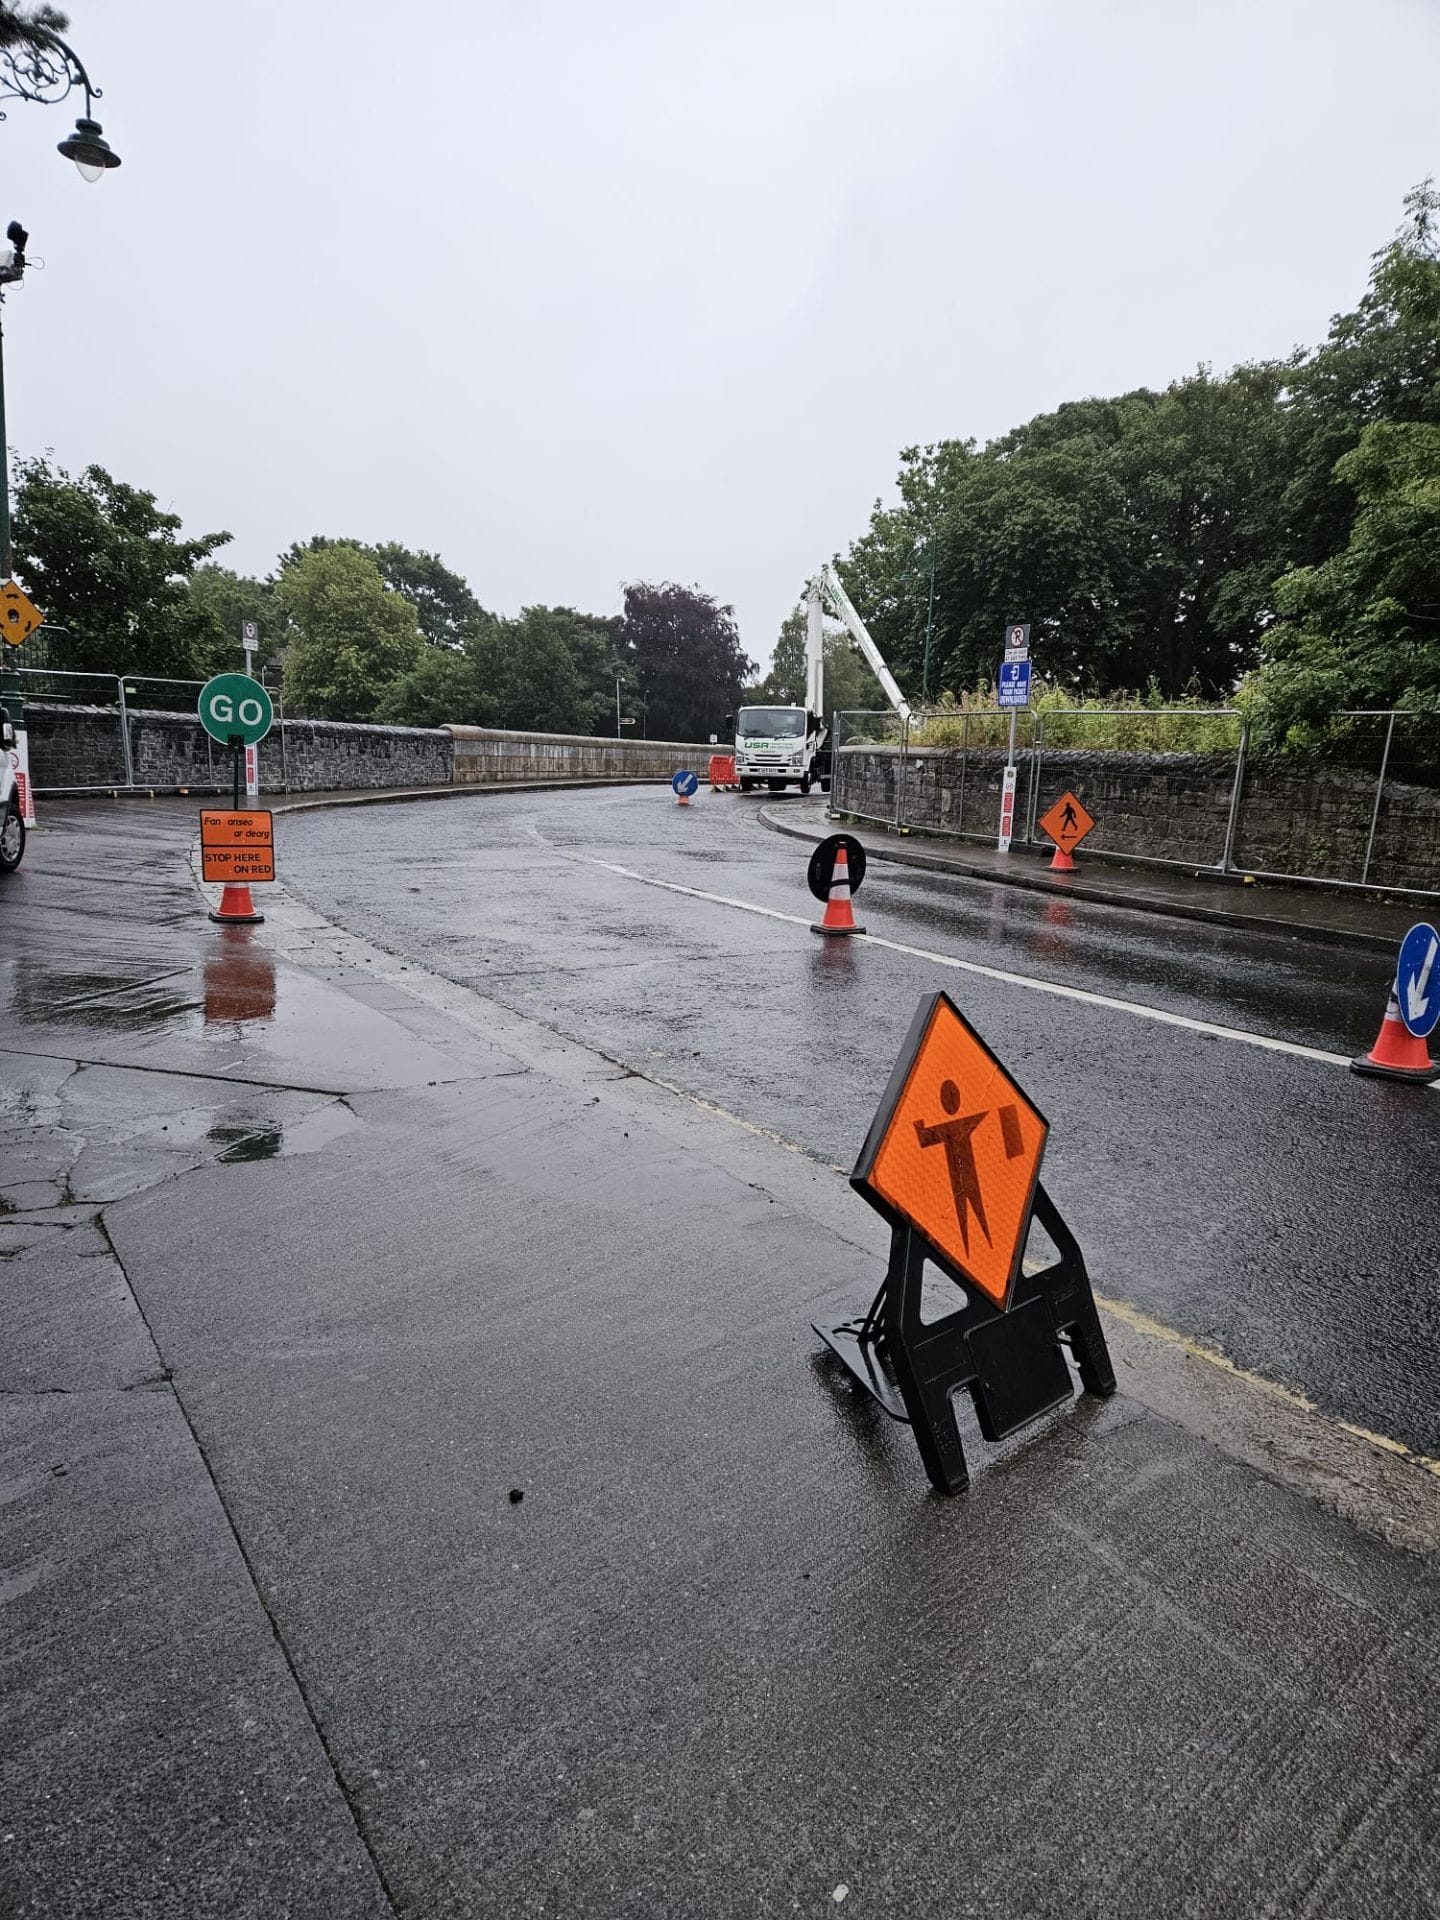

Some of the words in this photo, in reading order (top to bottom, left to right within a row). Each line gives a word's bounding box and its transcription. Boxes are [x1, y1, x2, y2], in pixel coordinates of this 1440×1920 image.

[210, 695, 262, 726] GO
[204, 817, 221, 825] Fan
[227, 818, 253, 826] anseo
[245, 828, 270, 839] dearg
[205, 854, 231, 862] STOP
[234, 865, 248, 873] ON
[251, 865, 271, 873] RED
